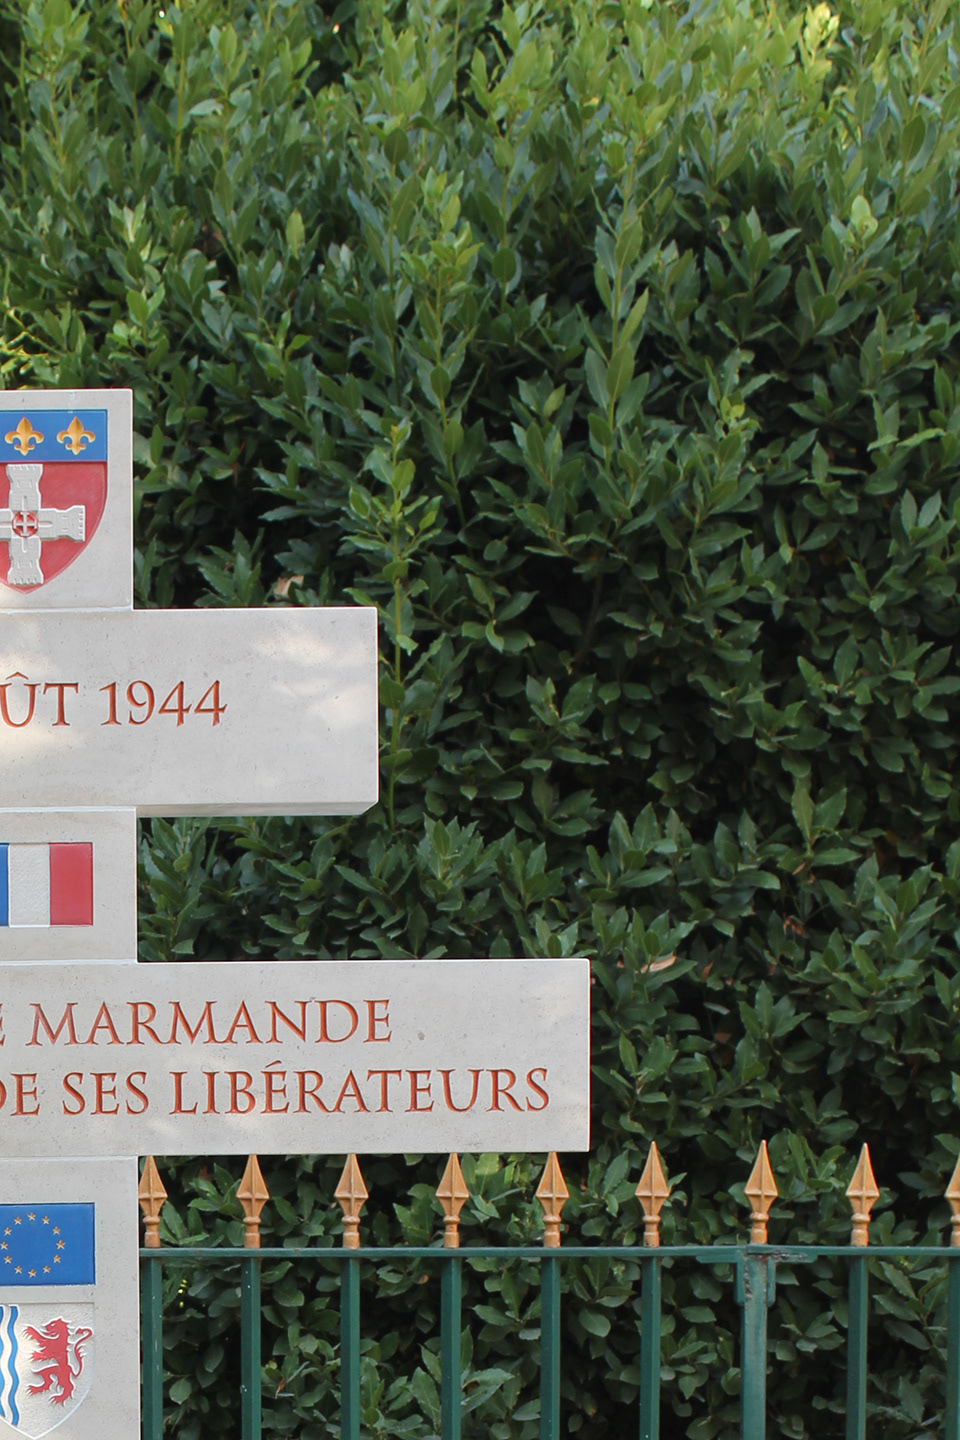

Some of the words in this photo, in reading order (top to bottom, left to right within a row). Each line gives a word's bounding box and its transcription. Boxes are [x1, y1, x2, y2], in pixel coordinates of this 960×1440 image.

[101, 680, 227, 727] 1944
[29, 999, 392, 1046] MARMANDE
[63, 1071, 149, 1116] SES
[171, 1060, 549, 1115] LIBÉRATEURS
